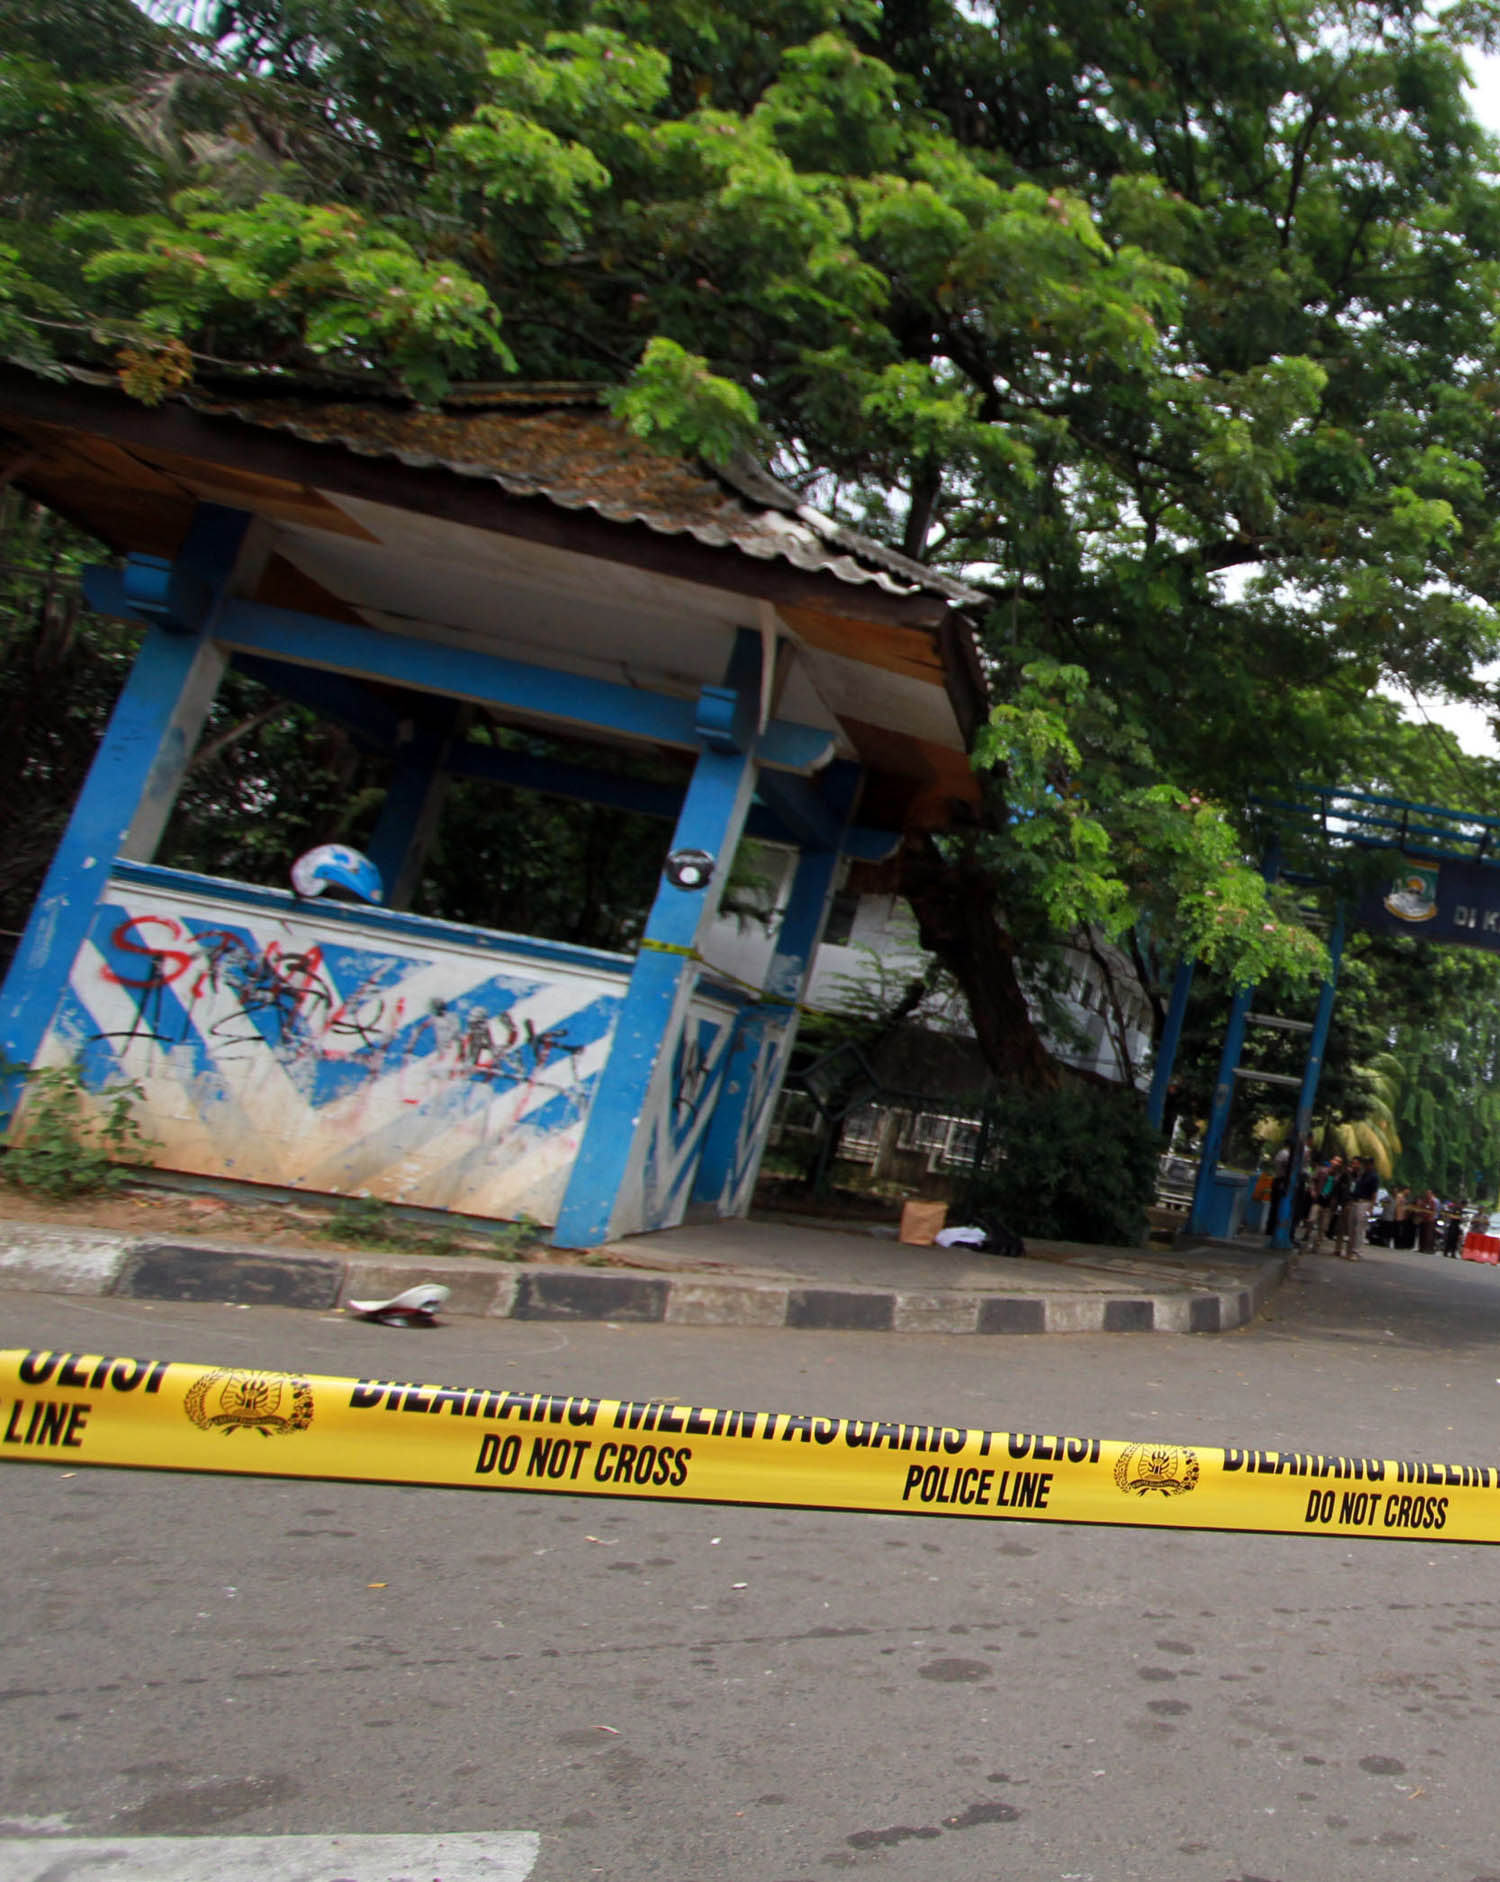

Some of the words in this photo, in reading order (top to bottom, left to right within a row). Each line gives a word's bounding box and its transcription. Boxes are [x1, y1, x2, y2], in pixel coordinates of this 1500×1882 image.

[1454, 905, 1478, 928] DI
[19, 1350, 171, 1393] OLII
[3, 1399, 92, 1447] LINE
[475, 1433, 523, 1475] DO
[526, 1437, 592, 1480] NOT
[594, 1442, 693, 1487] CROSS
[902, 1464, 996, 1506] POLICE
[996, 1471, 1054, 1508] LINE
[1305, 1489, 1336, 1523] DO
[1339, 1492, 1382, 1526] NOT
[1384, 1494, 1449, 1529] CROSS
